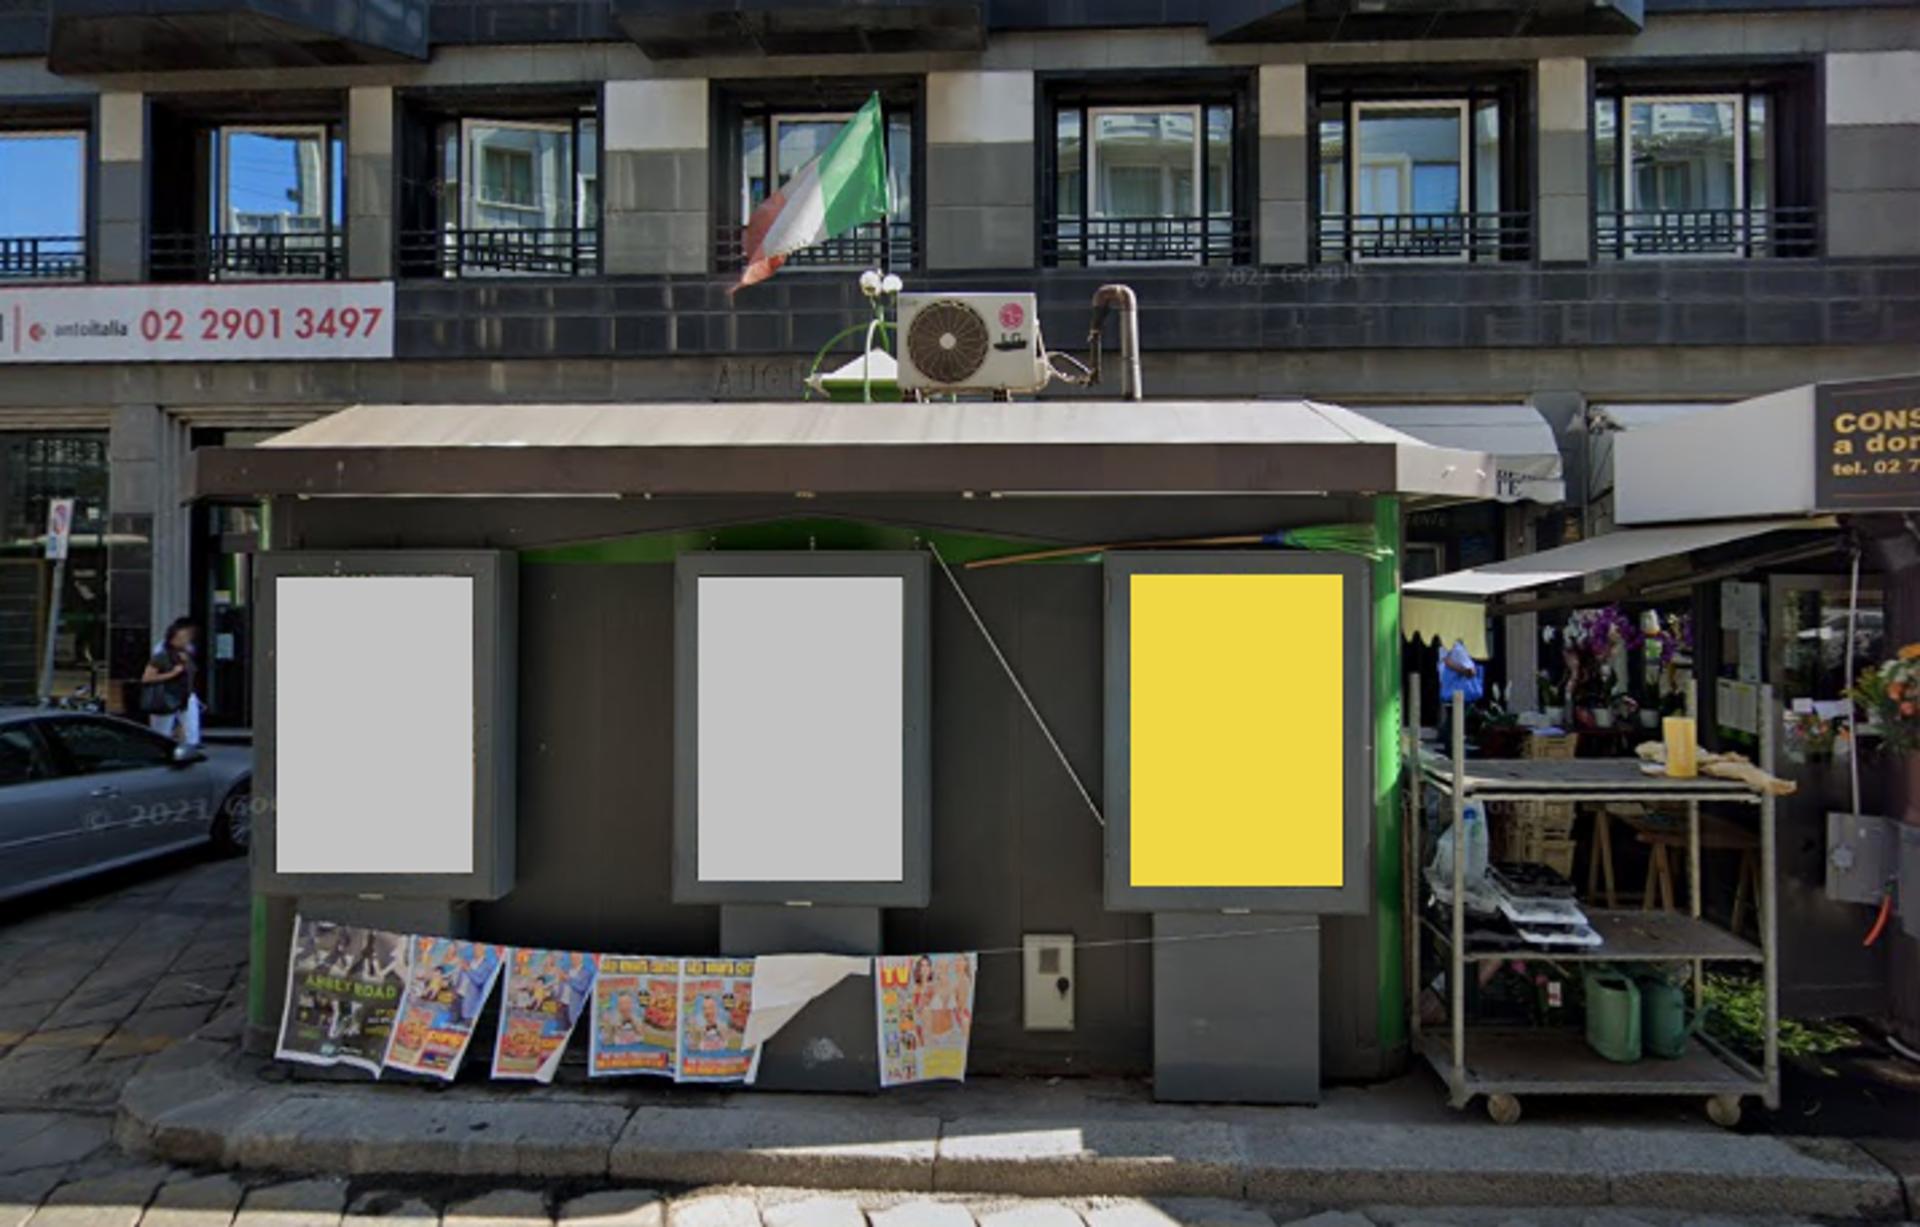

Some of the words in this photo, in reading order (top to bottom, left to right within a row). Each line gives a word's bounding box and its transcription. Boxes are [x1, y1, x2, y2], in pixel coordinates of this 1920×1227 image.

[140, 310, 183, 341] 02
[201, 309, 281, 341] 2901
[294, 307, 383, 340] 3497
[1833, 439, 1853, 455] a
[1832, 461, 1868, 476] tel.
[1873, 459, 1901, 474] 02
[882, 965, 910, 985] TV
[354, 982, 397, 1000] ROAD
